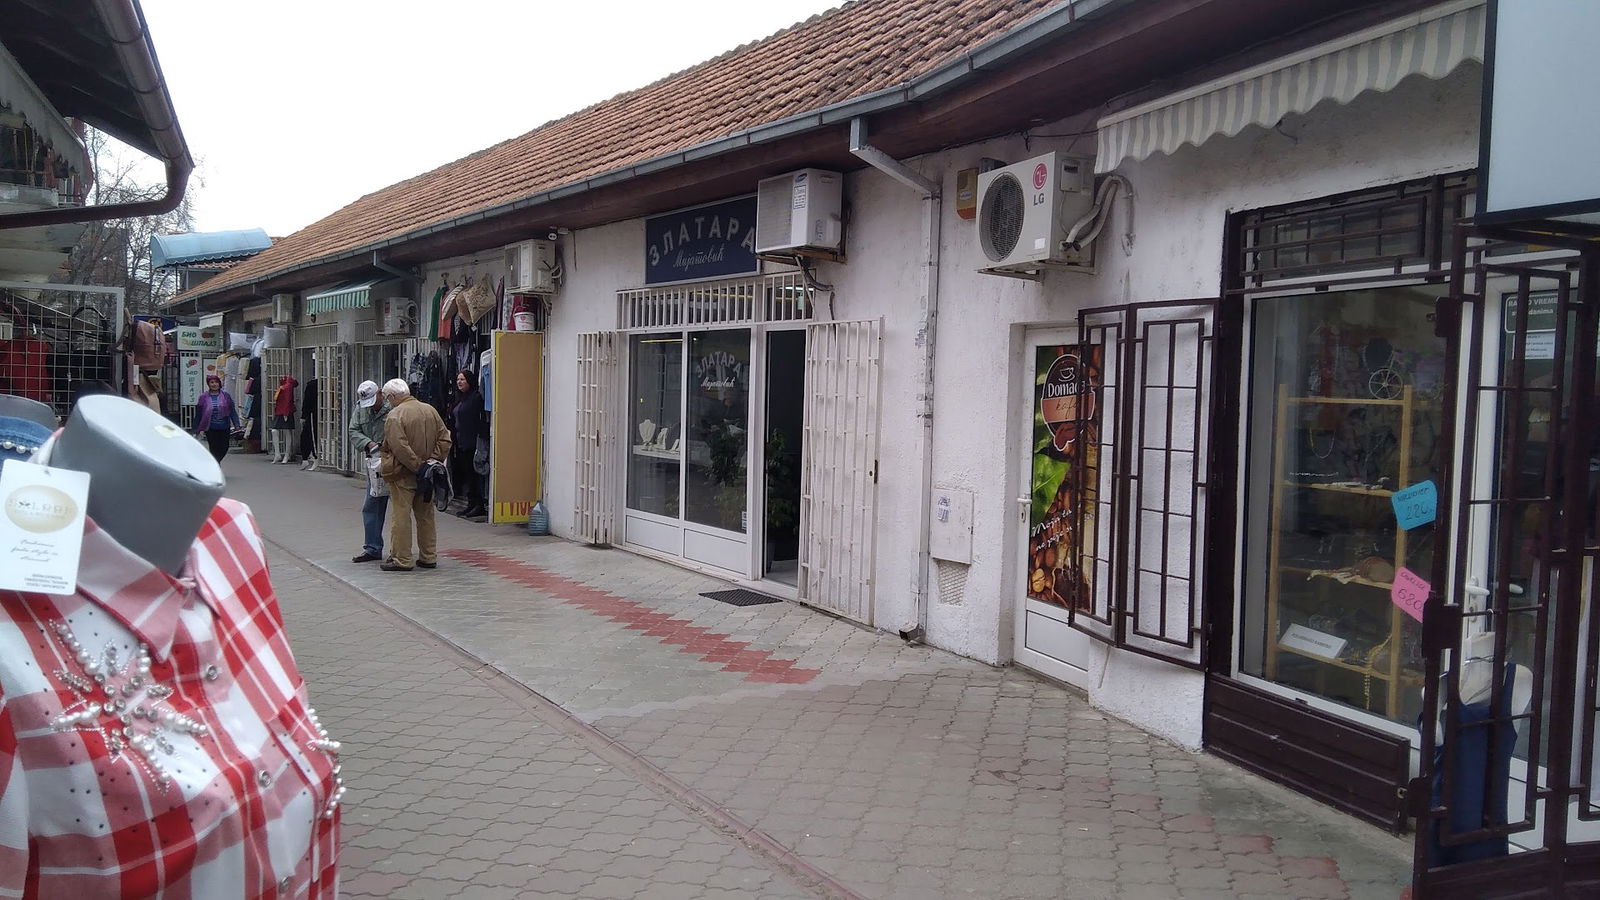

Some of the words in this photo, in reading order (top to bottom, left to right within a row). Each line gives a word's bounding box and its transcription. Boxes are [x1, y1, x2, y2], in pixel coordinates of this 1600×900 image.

[1033, 192, 1045, 206] LG
[648, 215, 755, 267] ЗЛАТАРА
[695, 351, 742, 379] ЗЛАТАРА
